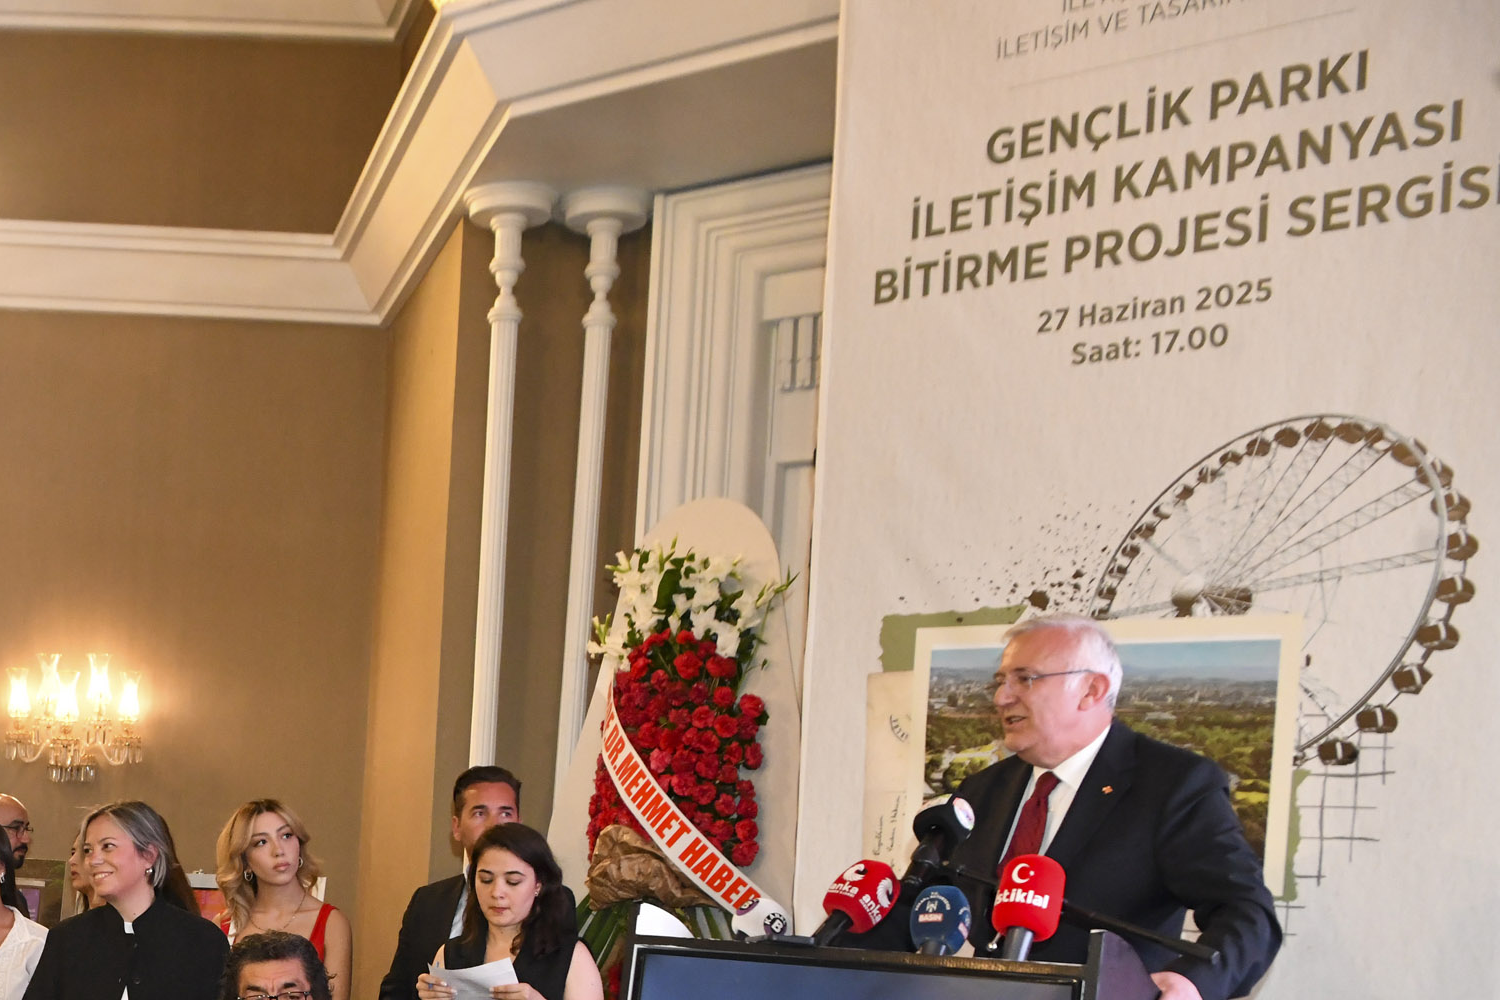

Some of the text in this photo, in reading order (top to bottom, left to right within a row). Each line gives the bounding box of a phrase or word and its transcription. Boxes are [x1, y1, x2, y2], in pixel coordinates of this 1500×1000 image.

[1099, 9, 1129, 34] VE
[986, 49, 1371, 166] GENÇLİK PARKI
[909, 99, 1465, 241] İLETİŞİM KAMPANYASI
[873, 241, 1049, 305] BİTİRME
[1063, 193, 1270, 275] PROJESİ
[1037, 277, 1274, 334] 27 Haziran 2025
[1071, 323, 1230, 366] Saat: 17.00
